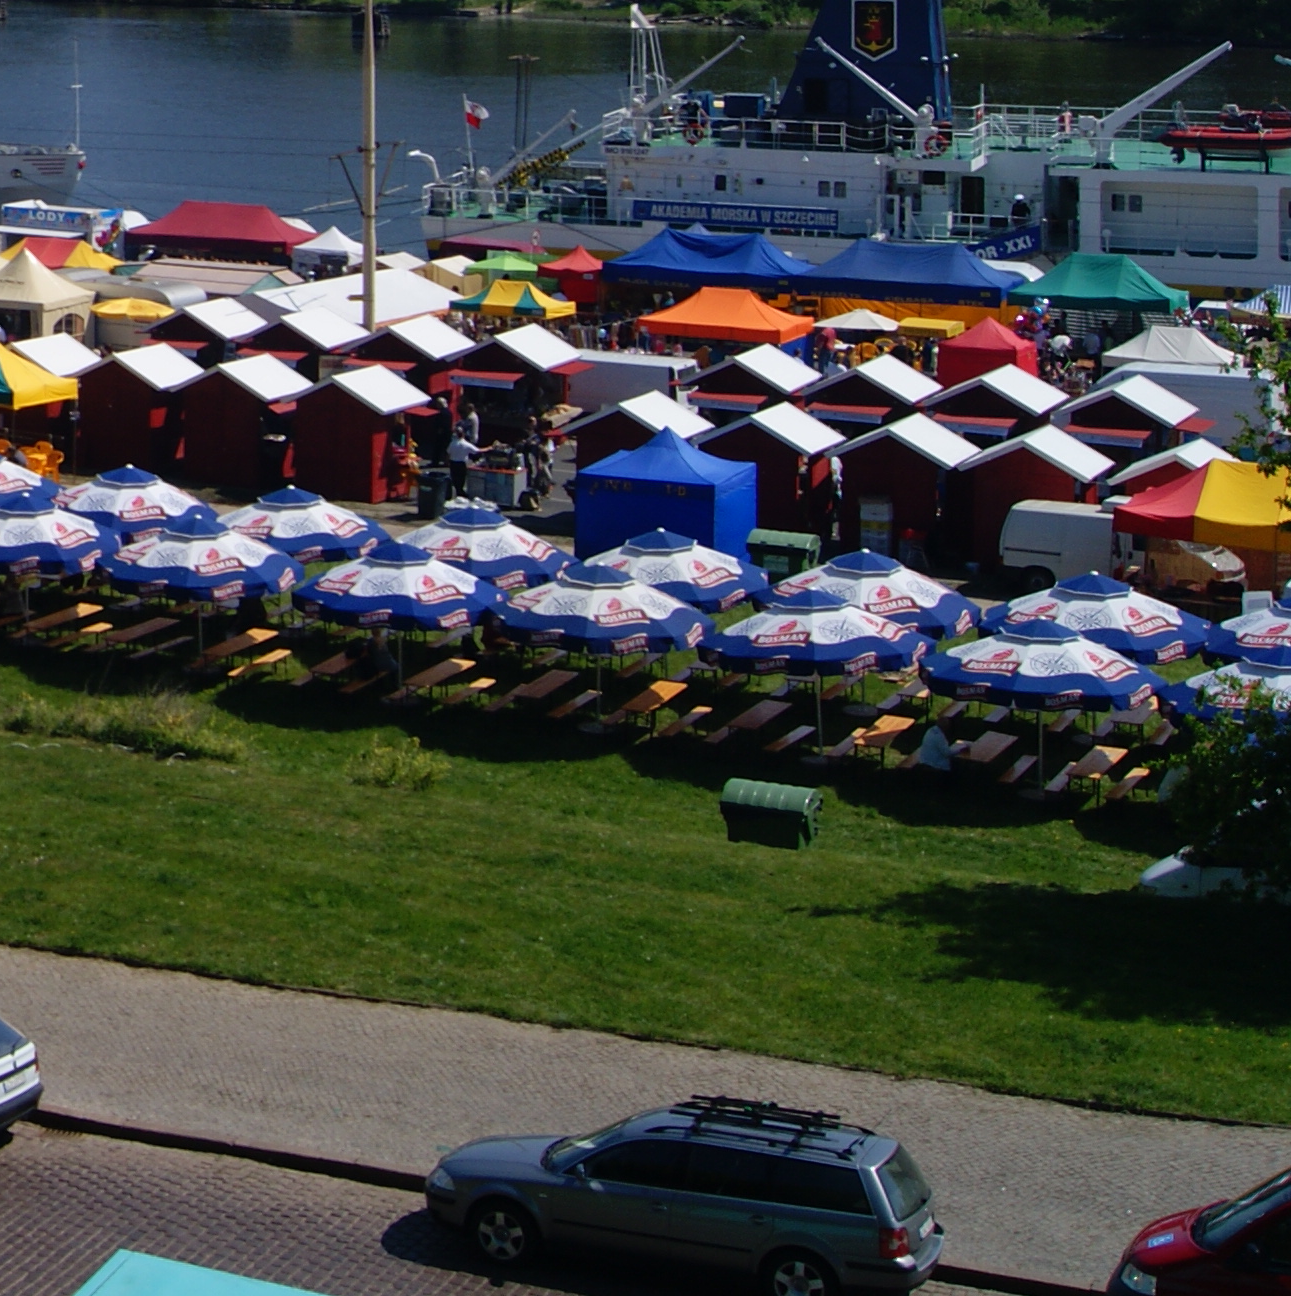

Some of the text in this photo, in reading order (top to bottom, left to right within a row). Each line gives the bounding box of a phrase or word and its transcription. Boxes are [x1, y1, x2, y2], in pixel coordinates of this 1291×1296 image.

[28, 209, 66, 222] LODY
[651, 205, 838, 226] AKADEMIA MORSKA W SZCZECINIE
[869, 599, 911, 612] BOSMAN
[599, 610, 642, 623] BOSMAN
[756, 634, 806, 644] BOSMAN
[967, 661, 1014, 671] BOSMAN
